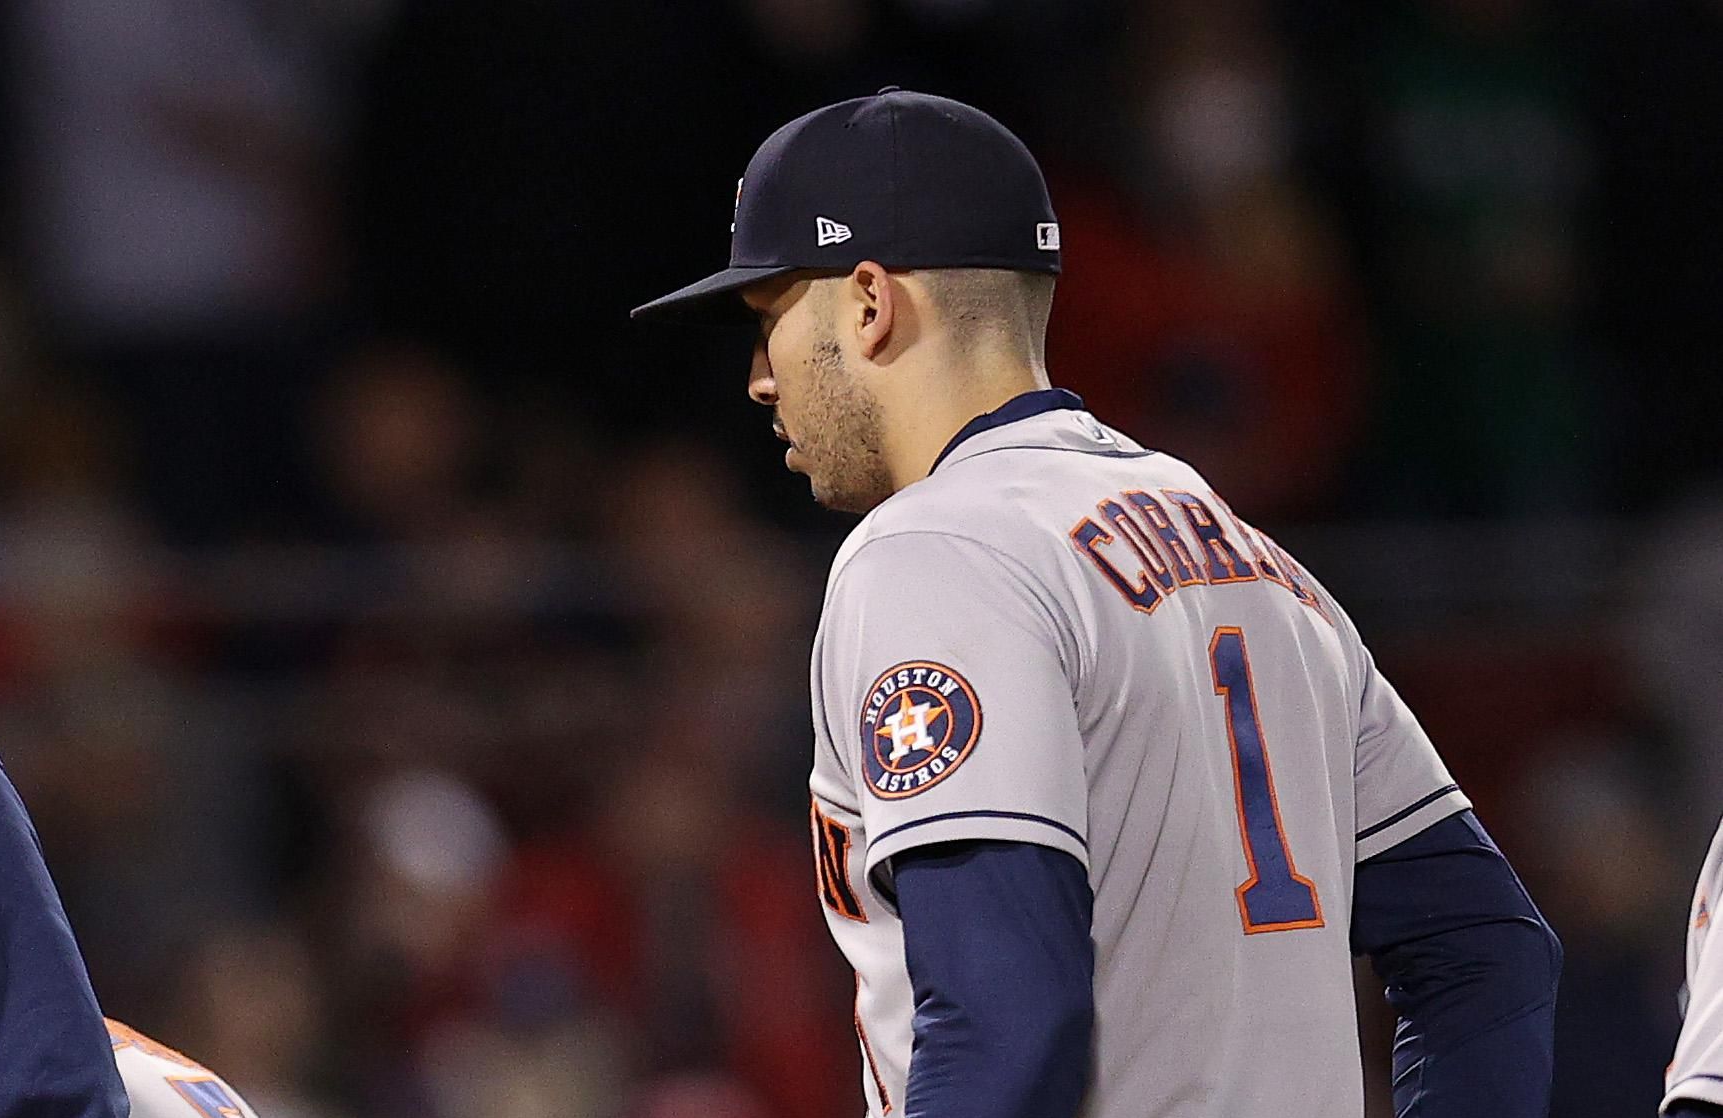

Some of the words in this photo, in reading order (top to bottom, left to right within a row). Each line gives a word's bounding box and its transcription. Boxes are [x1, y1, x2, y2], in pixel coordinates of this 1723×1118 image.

[1069, 487, 1335, 628] CORR
[865, 668, 960, 725] HOUSTON
[884, 701, 934, 761] H
[875, 746, 960, 793] ASTROS
[1207, 625, 1326, 936] 1
